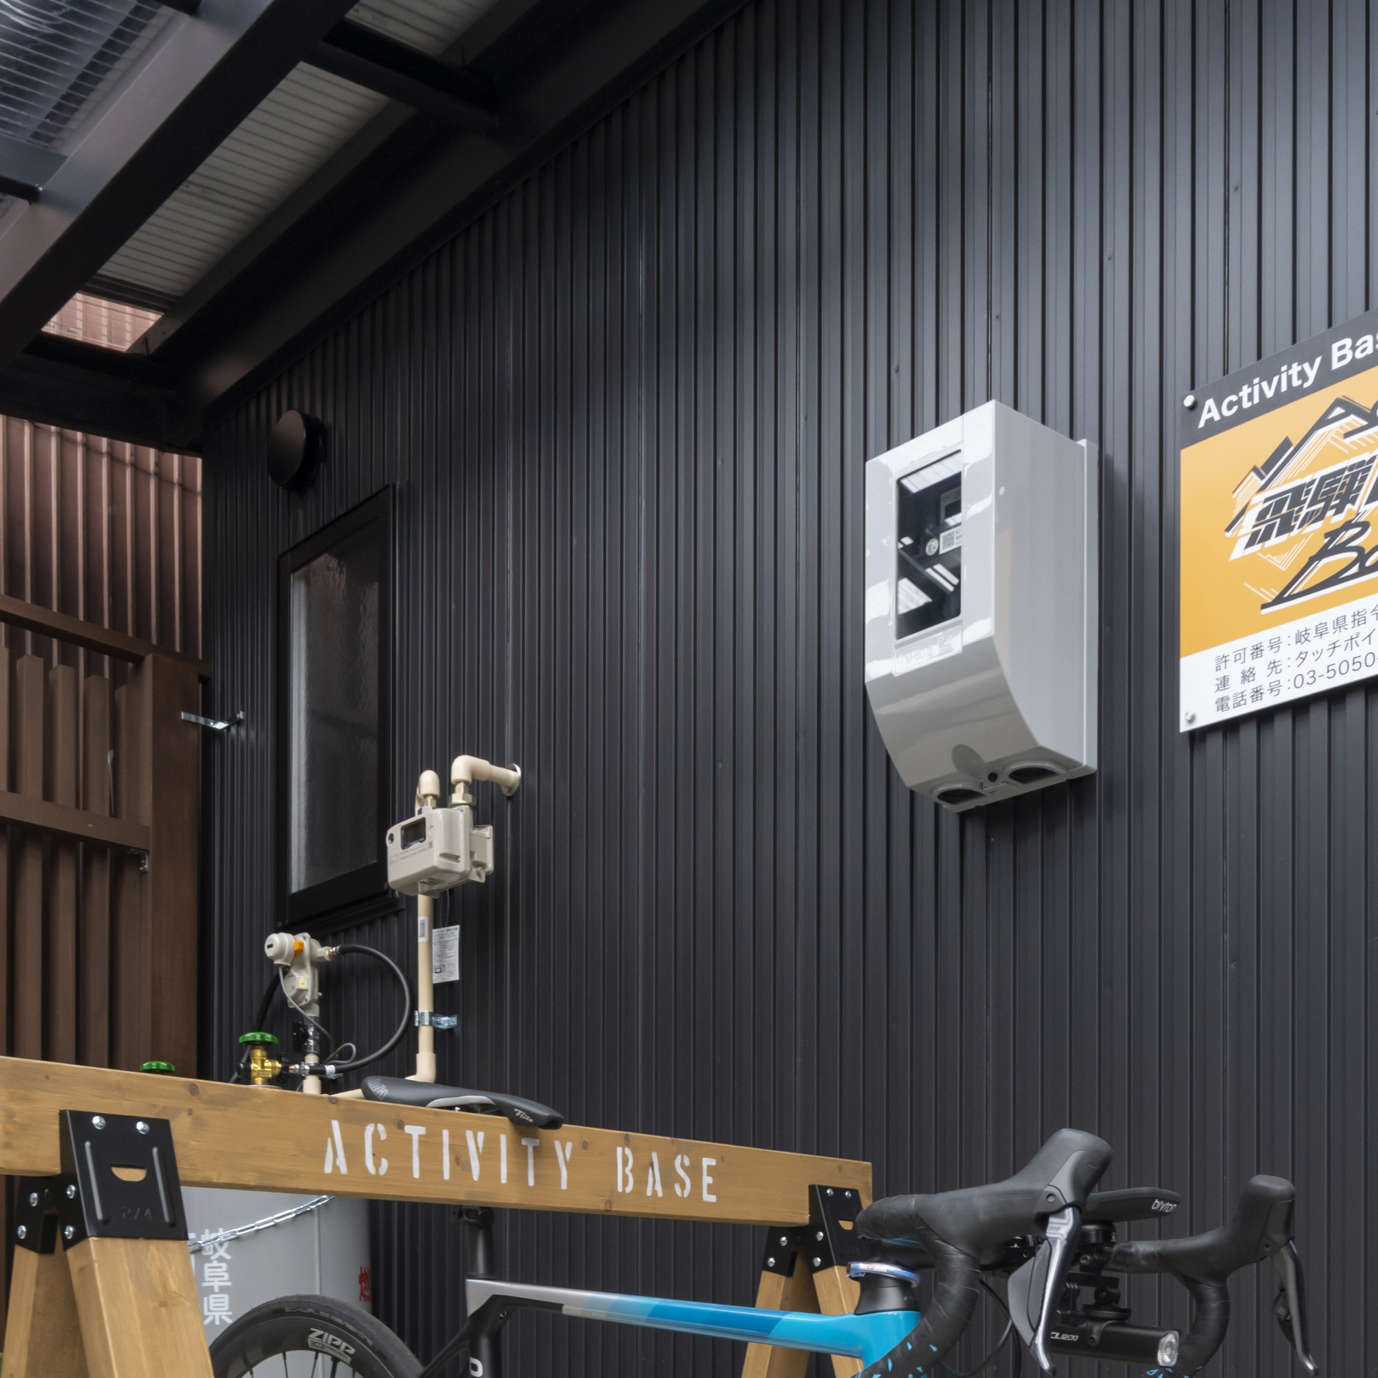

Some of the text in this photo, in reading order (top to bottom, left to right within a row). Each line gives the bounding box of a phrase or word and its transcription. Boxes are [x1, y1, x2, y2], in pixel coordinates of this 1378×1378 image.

[1197, 355, 1322, 429] Activity
[323, 1119, 717, 1203] ACTIVITY BASE
[307, 1327, 357, 1355] ZIPP
